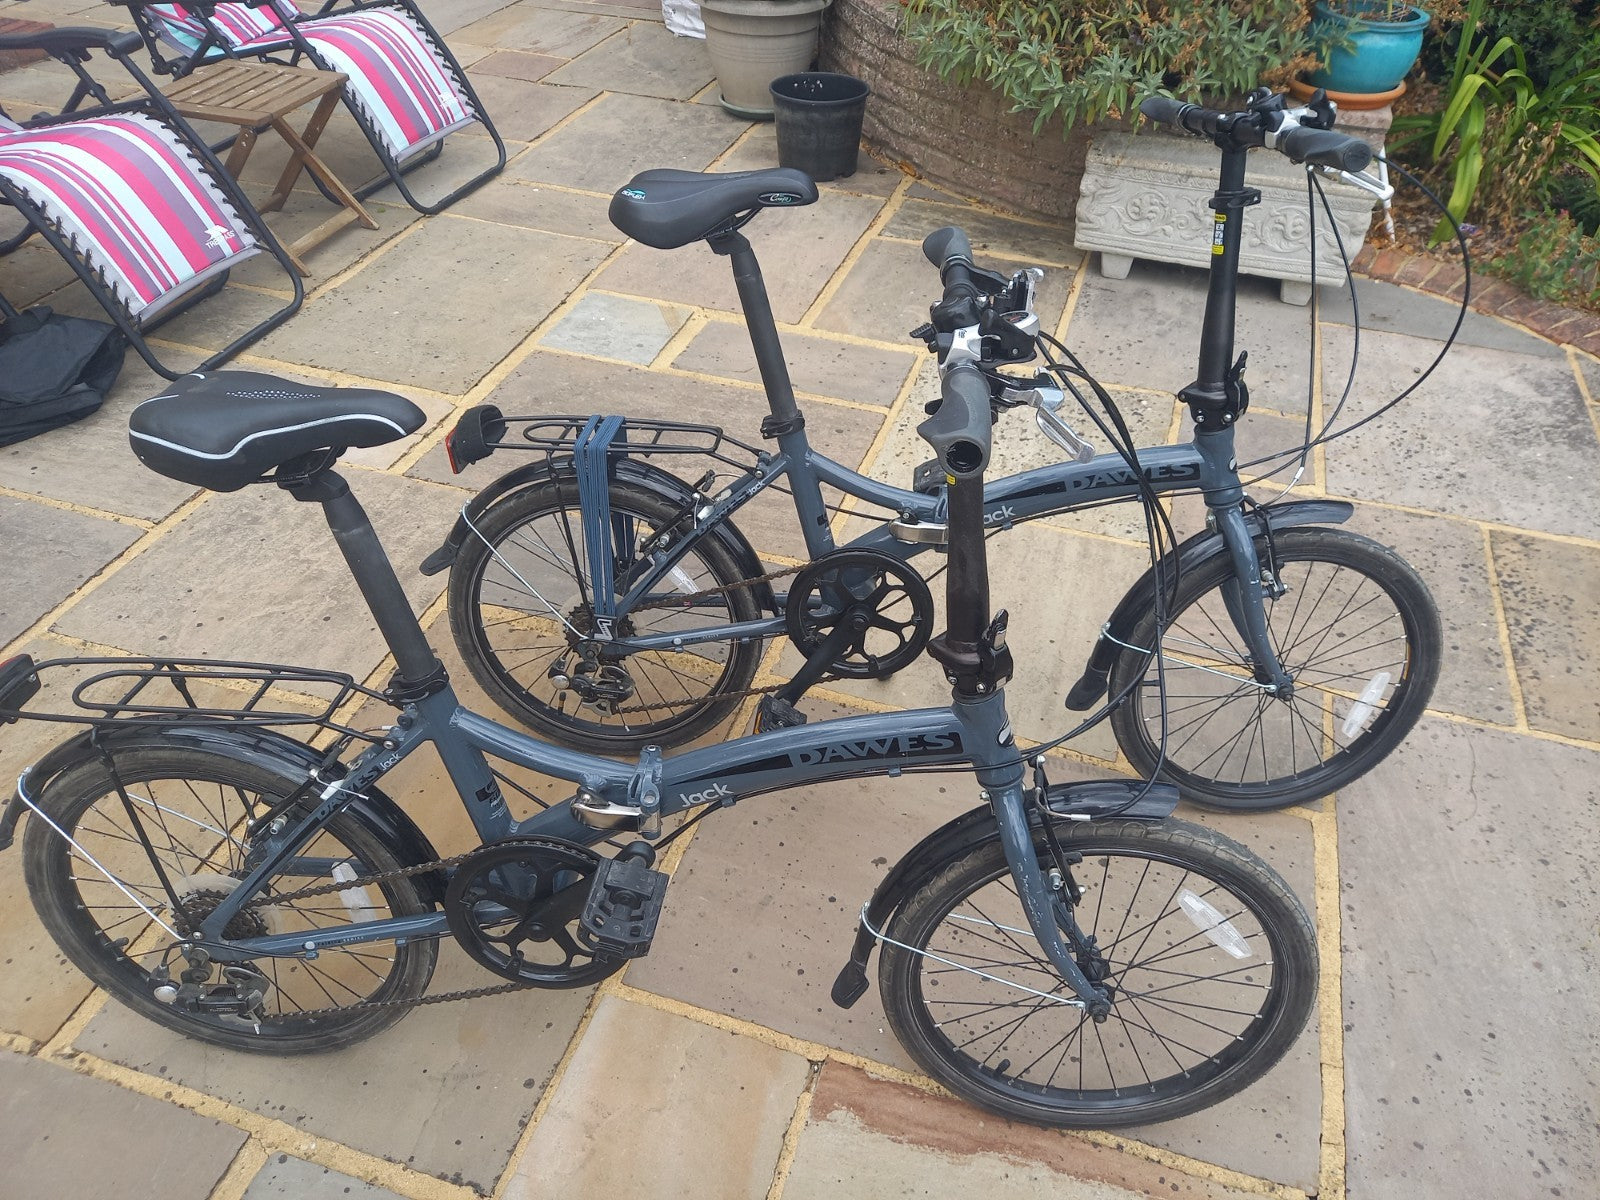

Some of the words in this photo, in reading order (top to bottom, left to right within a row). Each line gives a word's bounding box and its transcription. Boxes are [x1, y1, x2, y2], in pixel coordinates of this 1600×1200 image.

[983, 505, 1016, 525] ack
[790, 732, 955, 767] DAWES
[379, 752, 402, 772] Jack
[679, 782, 735, 809] Jack
